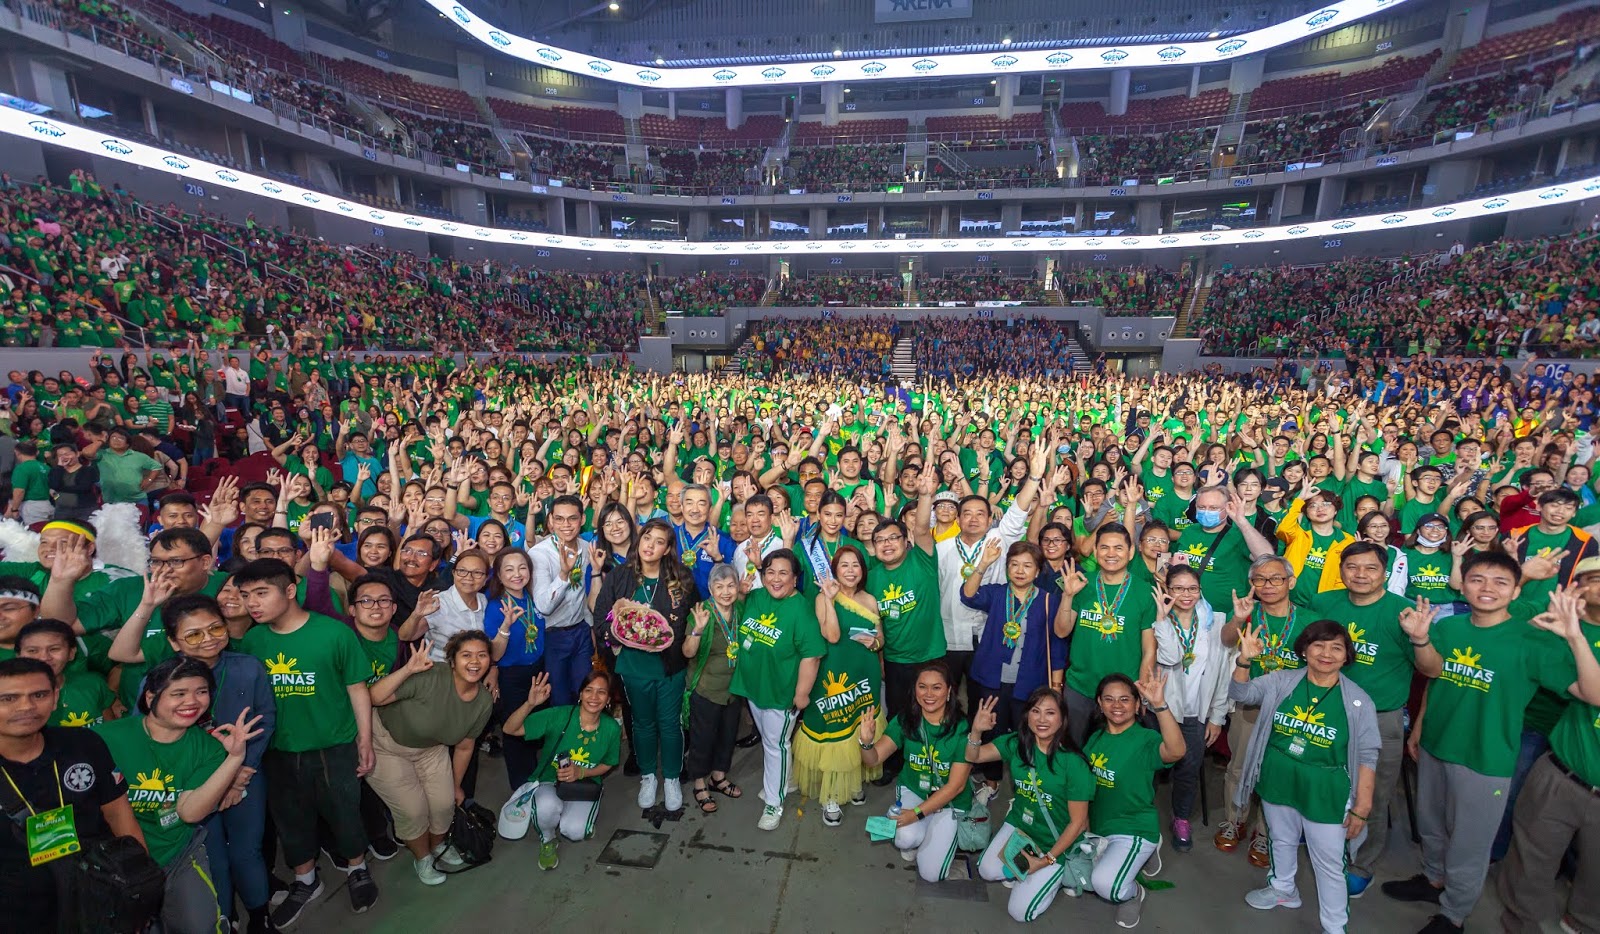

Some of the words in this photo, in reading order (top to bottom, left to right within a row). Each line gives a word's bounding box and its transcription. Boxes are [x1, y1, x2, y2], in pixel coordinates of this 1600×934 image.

[1309, 14, 1335, 27] ARENA
[1219, 44, 1244, 54] ARENA
[639, 72, 658, 81] ARENA
[187, 184, 204, 196] 218
[1324, 240, 1342, 248] 203
[1080, 609, 1125, 626] PILIPS
[743, 617, 782, 640] PILIPINAS
[271, 672, 316, 685] PINAS
[1442, 661, 1495, 683] LIPINAS
[1274, 711, 1338, 740] PILIPINAS
[127, 789, 183, 802] LIPINA
[32, 851, 57, 863] MEDIC
